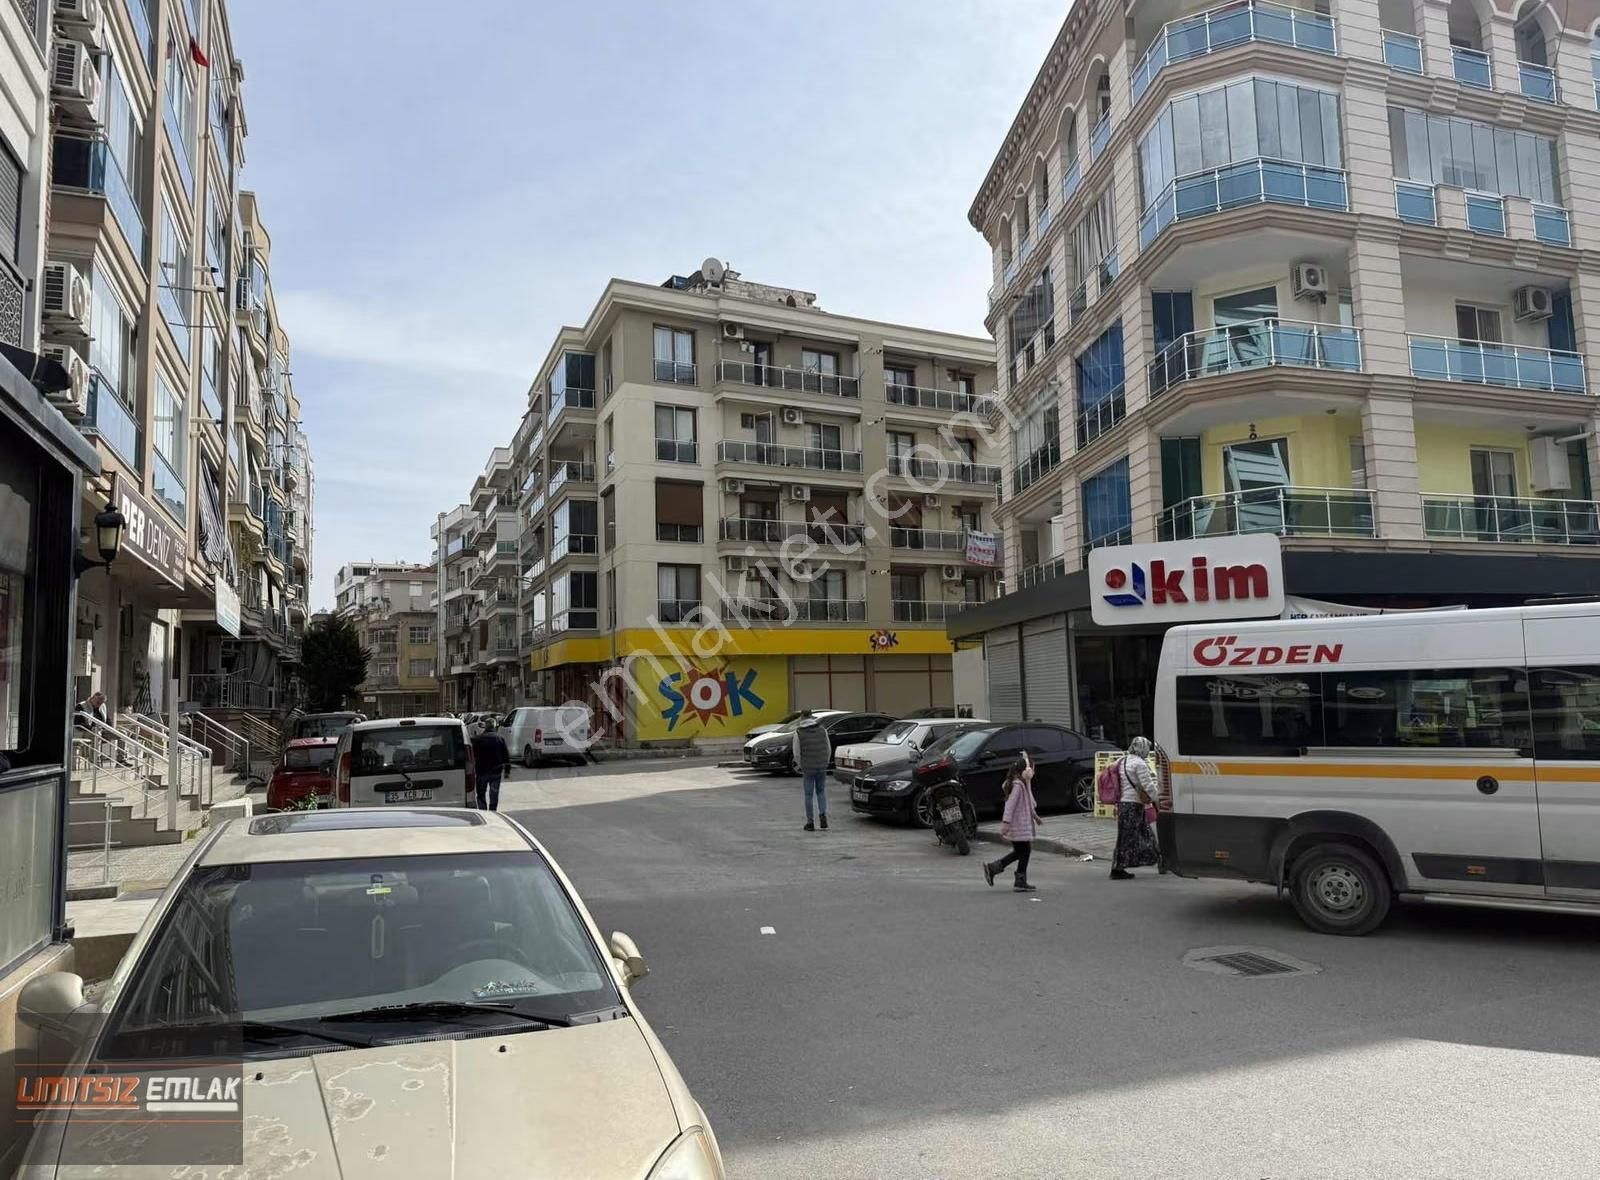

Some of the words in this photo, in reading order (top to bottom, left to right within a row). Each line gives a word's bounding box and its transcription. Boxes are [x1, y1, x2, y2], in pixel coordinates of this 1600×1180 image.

[1150, 556, 1269, 604] kim
[869, 632, 899, 652] ŞOK
[1193, 636, 1344, 667] ÖZDEN
[659, 667, 765, 732] ŞOK
